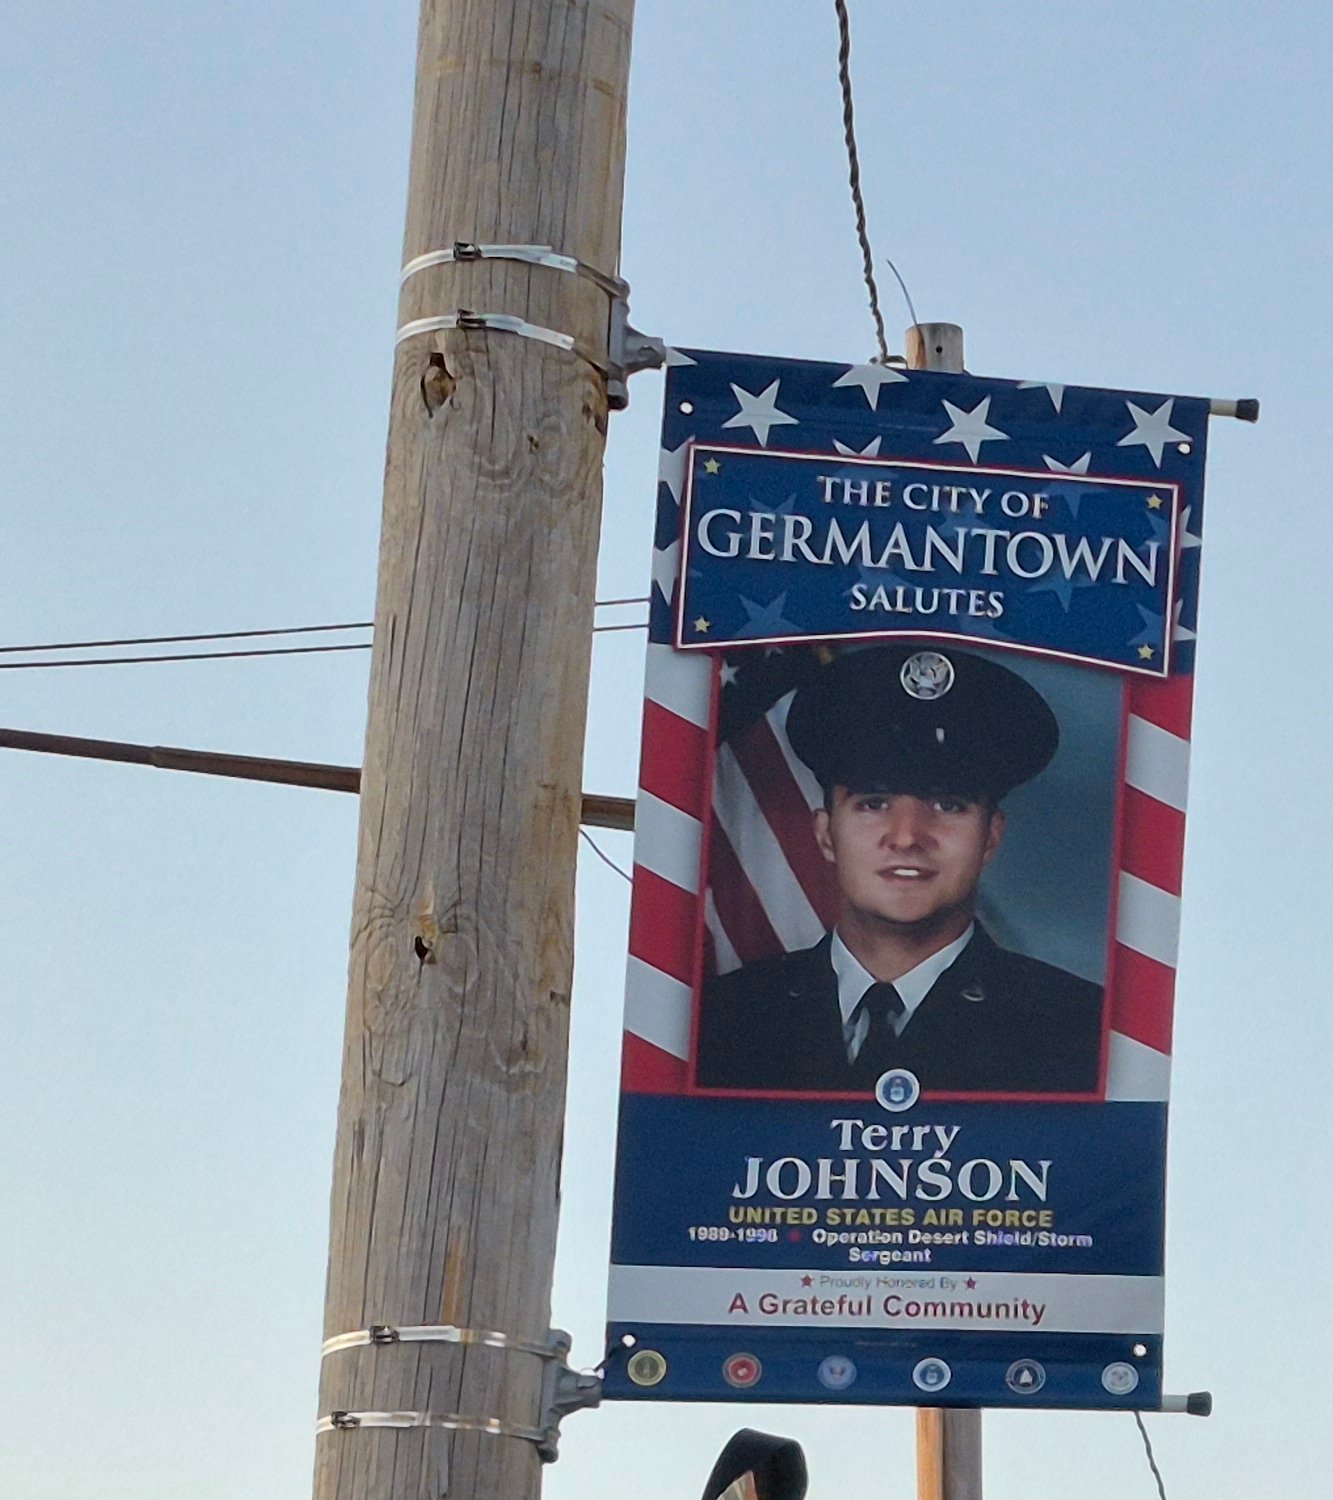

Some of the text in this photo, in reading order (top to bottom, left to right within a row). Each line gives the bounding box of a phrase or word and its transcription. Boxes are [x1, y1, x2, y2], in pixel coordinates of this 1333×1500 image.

[817, 475, 1050, 519] THE CITY OF
[697, 507, 1160, 588] GERMANTOWN
[849, 582, 1004, 619] SALUTES
[830, 1119, 961, 1160] Terry
[732, 1156, 1053, 1202] JOHNSON
[729, 1205, 1055, 1228] UNITED STATES AIR FORCE
[812, 1228, 903, 1248] Operation
[908, 1229, 969, 1246] Desert
[974, 1230, 1093, 1248] Shield/Storm
[848, 1246, 932, 1266] Sergeant
[819, 1275, 958, 1291] Proudly Honored By
[728, 1292, 1046, 1327] A Grateful Community
